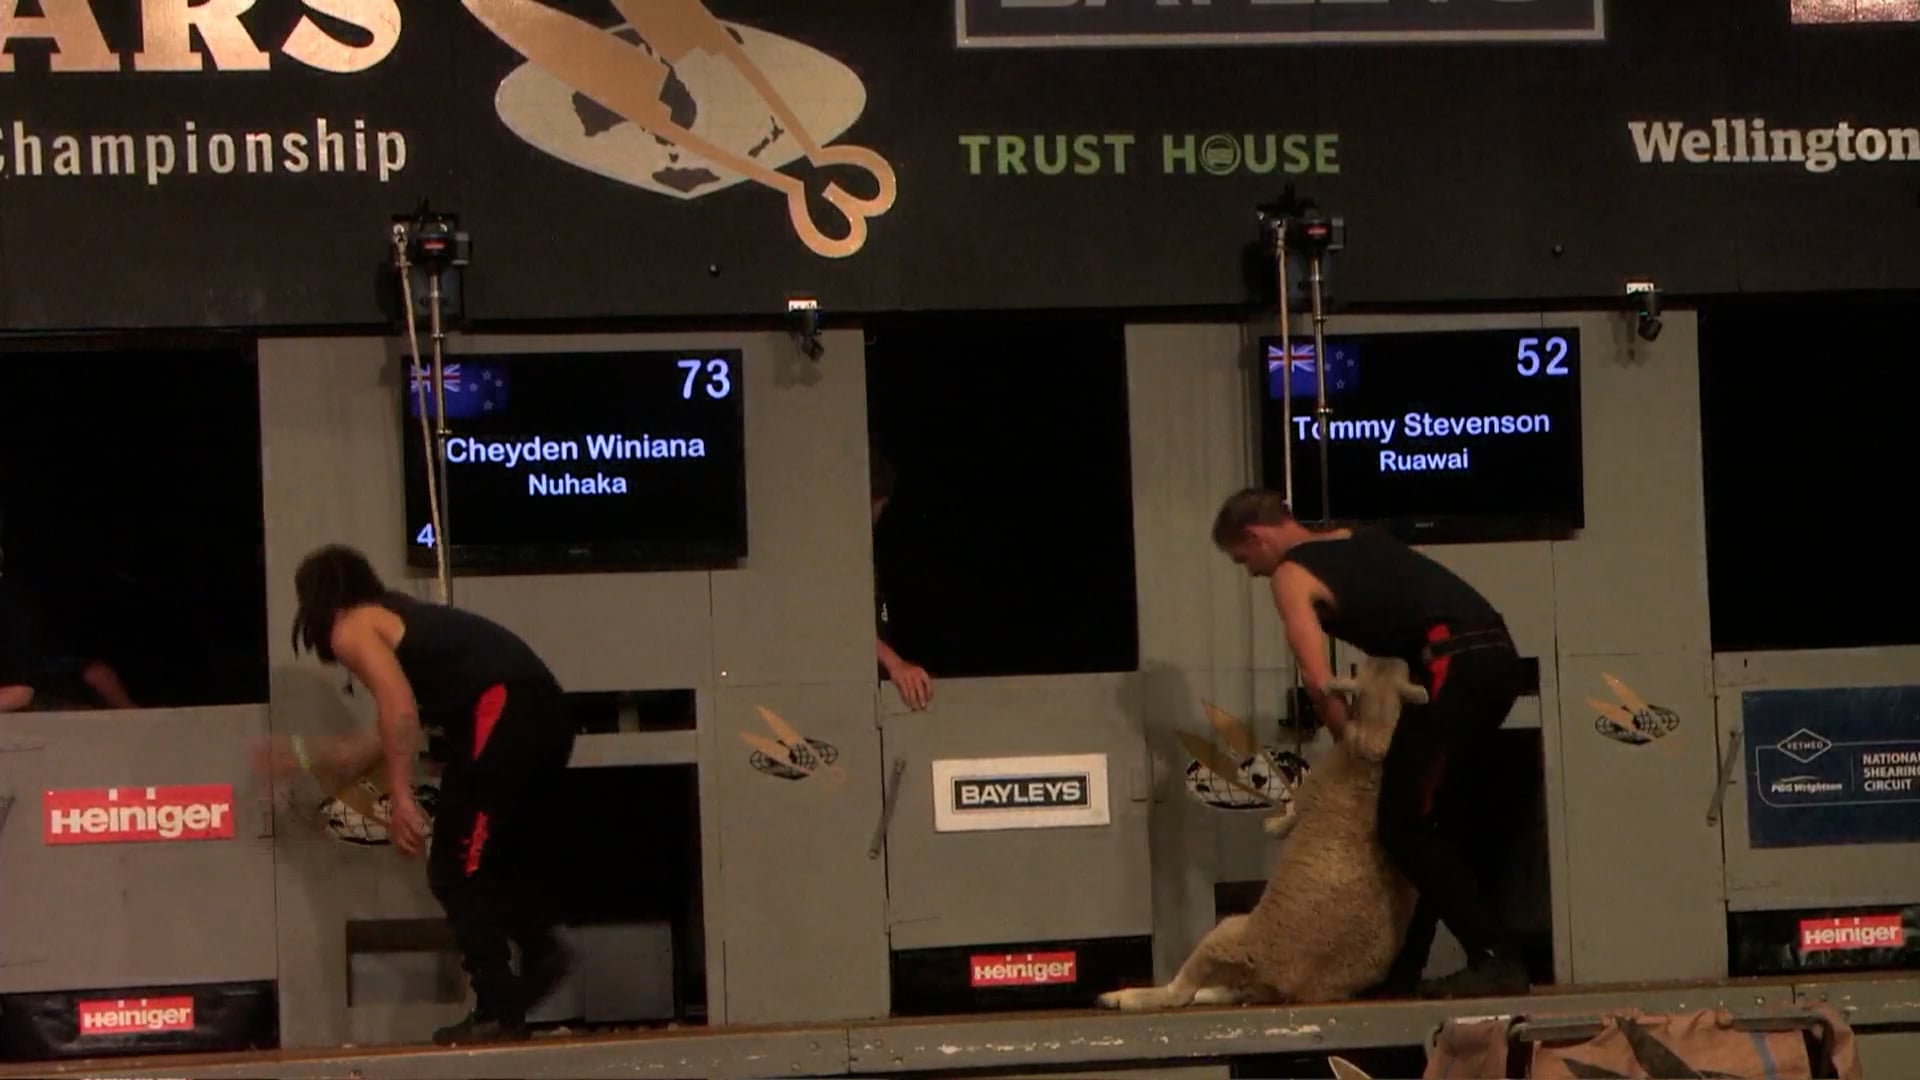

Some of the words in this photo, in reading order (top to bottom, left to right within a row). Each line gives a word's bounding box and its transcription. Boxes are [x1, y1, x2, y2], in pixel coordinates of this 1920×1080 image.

[0, 117, 407, 185] hampionship
[959, 134, 1135, 174] TRUST
[1163, 133, 1340, 175] HOUSE
[1628, 118, 1920, 173] Wellington
[1516, 336, 1569, 377] 52
[677, 358, 731, 399] 73
[1403, 412, 1550, 437] Stevenson
[447, 436, 579, 468] Cheyden
[586, 433, 706, 460] Winiana
[1379, 447, 1469, 472] Ruawai
[528, 471, 628, 497] Nuhaka
[1863, 752, 1920, 765] NATIONA
[960, 780, 1082, 805] BAYLEYS
[1864, 778, 1912, 792] CIRCUIT
[51, 787, 229, 838] Heiniger
[1804, 917, 1900, 945] Heiniger
[974, 954, 1073, 981] Heiniger
[83, 999, 191, 1029] Heiniger
